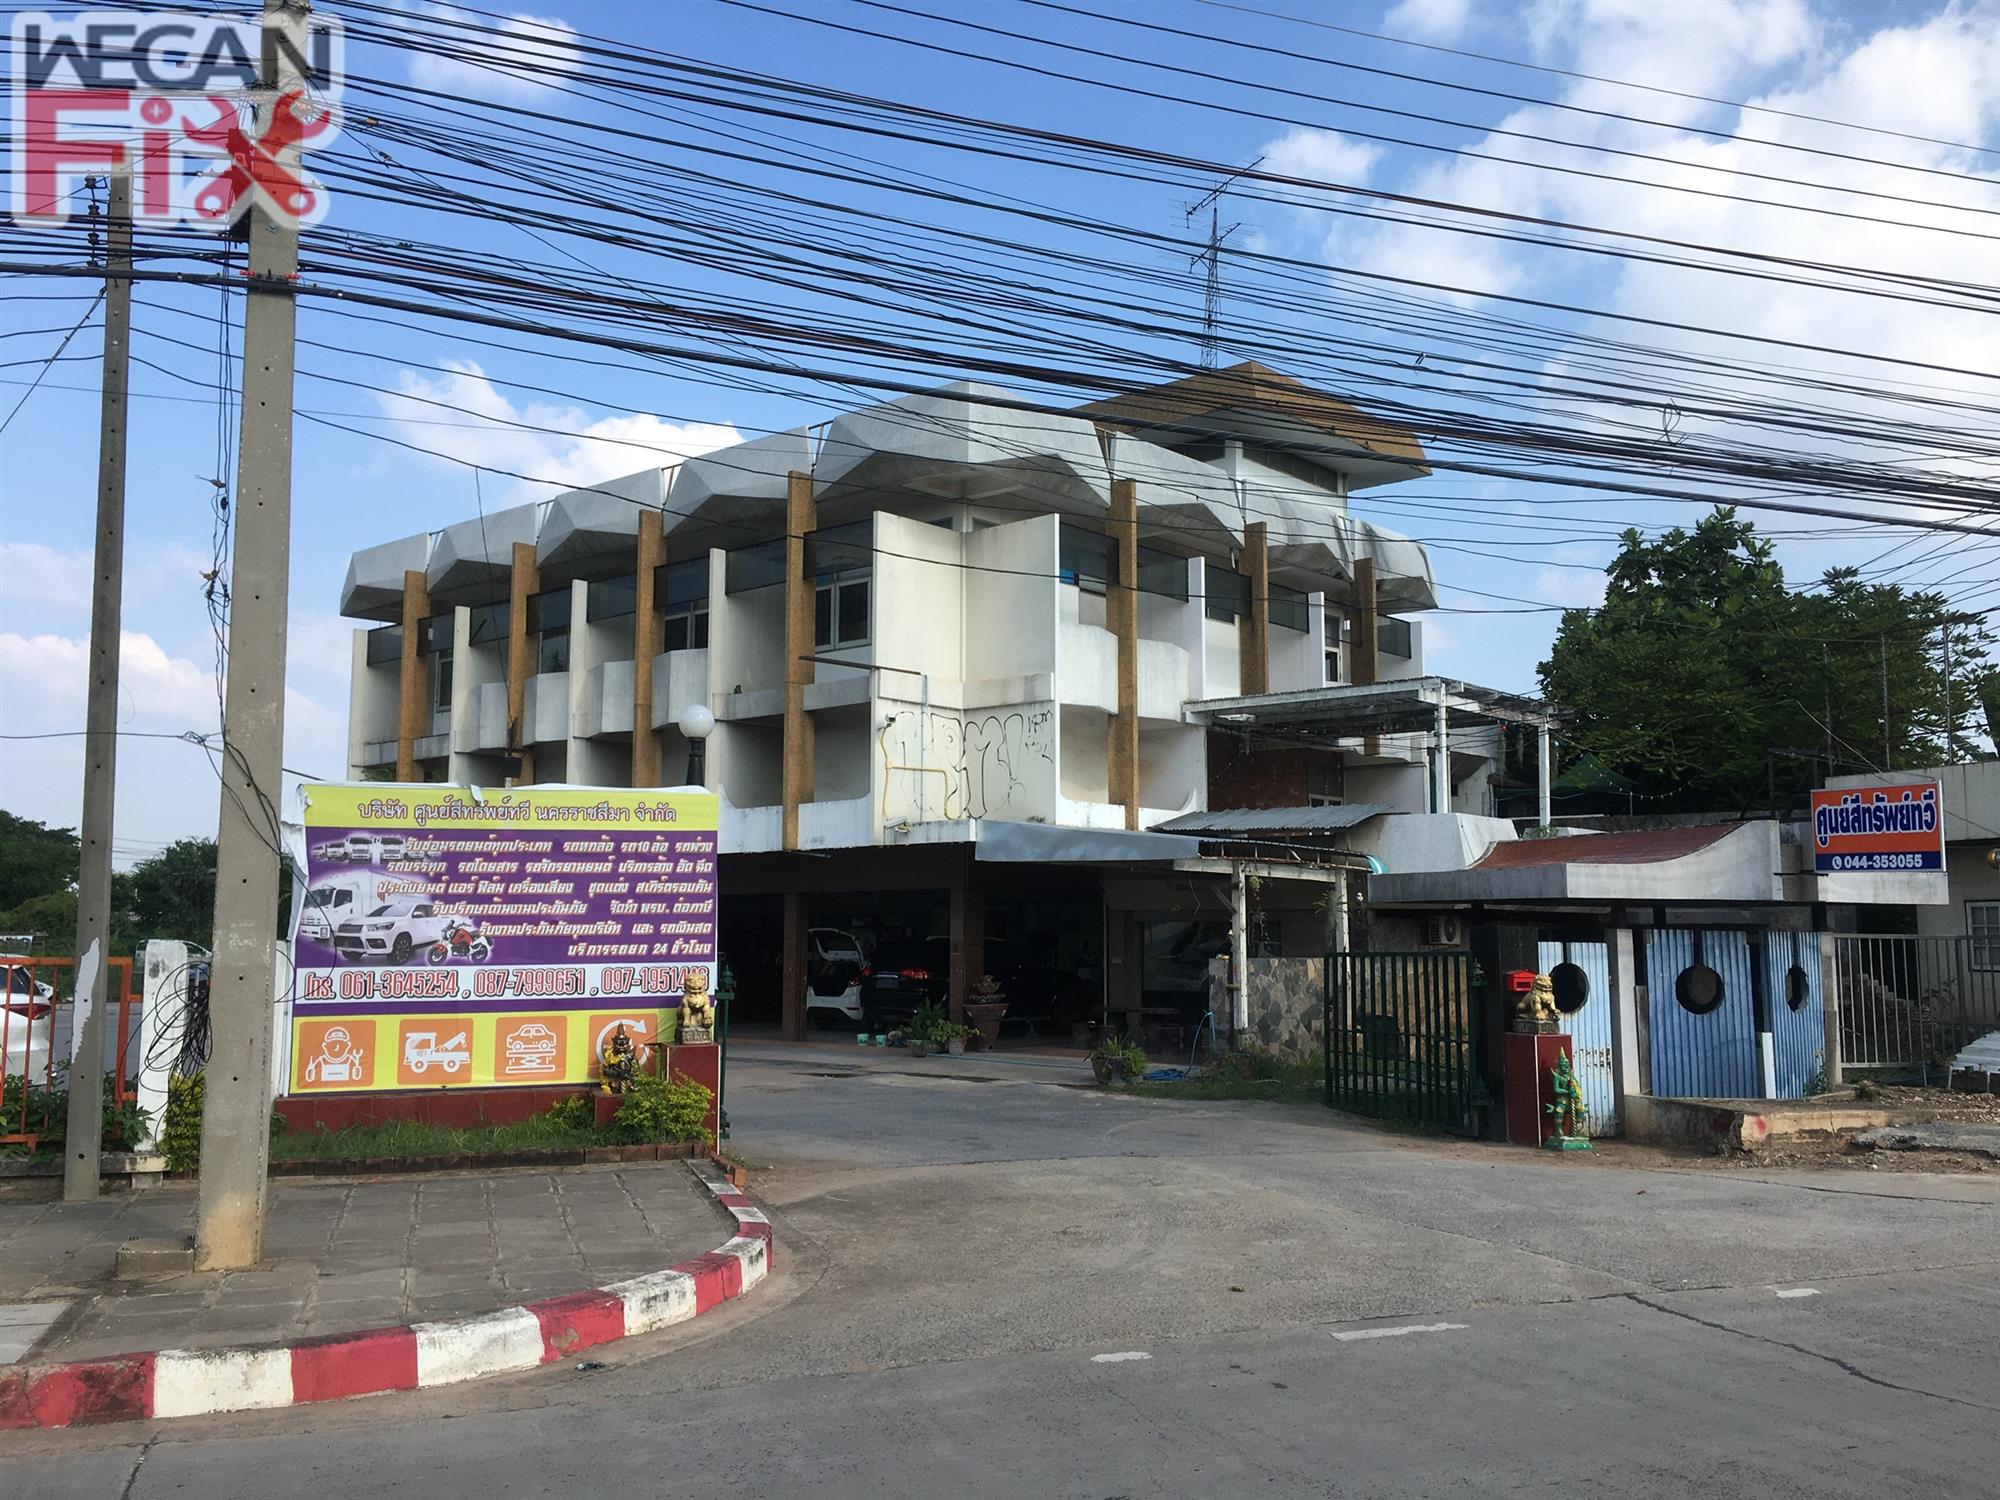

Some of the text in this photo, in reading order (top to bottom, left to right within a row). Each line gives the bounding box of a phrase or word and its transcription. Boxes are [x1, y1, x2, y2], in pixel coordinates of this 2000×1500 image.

[358, 799, 407, 819] บริษัท
[535, 803, 629, 822] นครราชสีมา
[634, 802, 676, 822] จำกัด
[1816, 789, 1937, 848] ศูนย์สีทรัพย์ทวี
[406, 834, 553, 857] รับซ่อมรถยนต์ทุกประเภท
[563, 835, 615, 853] รถหกล้อ
[675, 836, 713, 853] รถพ่วง
[387, 860, 447, 877] รถบรรทุก
[458, 858, 518, 874] รถโดยสาร
[525, 855, 615, 873] รถจักรยานยนต์
[618, 856, 672, 873] บริการล้าง
[1844, 854, 1923, 869] 044-353055
[377, 876, 450, 894] ประดับยนต์
[448, 876, 478, 894] แอร์
[507, 877, 574, 894] เครื่องเสียง
[588, 877, 630, 898] ชุดแต่ง
[610, 900, 640, 915] จัดทำ
[672, 897, 713, 915] ต่อภาษี
[479, 919, 622, 938] รับงานประกันภัยทุกบริษัท
[632, 923, 653, 935] และ
[567, 938, 712, 957] บริการรถยก 24 ชั่วโมง
[304, 971, 336, 1001] โทร.
[340, 969, 460, 998] 061-3645254
[474, 967, 586, 997] 087-7999651
